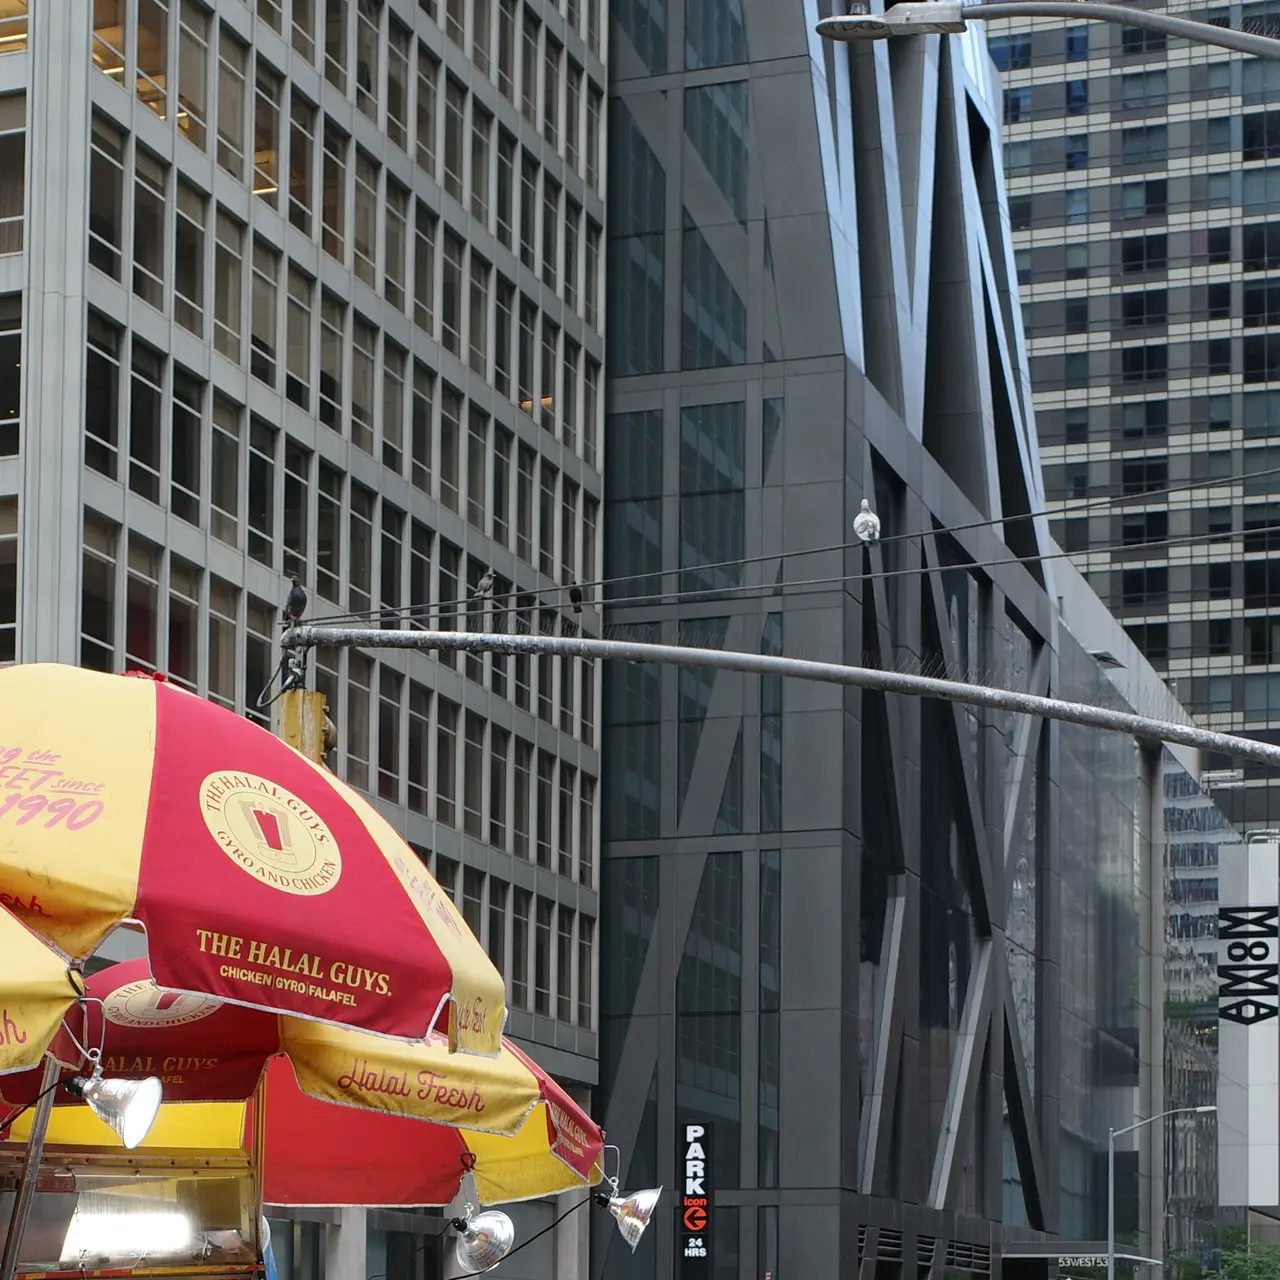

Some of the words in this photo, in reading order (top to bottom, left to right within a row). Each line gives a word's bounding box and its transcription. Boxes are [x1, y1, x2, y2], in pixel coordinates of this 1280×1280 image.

[26, 748, 62, 764] the
[52, 776, 106, 795] since
[206, 780, 226, 812] THE
[220, 775, 282, 800] HALAL
[286, 798, 330, 845] GUYS
[217, 830, 254, 868] GYRO
[256, 866, 291, 888] AND
[292, 858, 337, 890] CHICKEN
[196, 929, 243, 962] THE
[247, 940, 324, 981] HALAL
[114, 982, 146, 1000] THE
[218, 964, 273, 989] CHICKEN
[275, 974, 306, 995] GYRO
[308, 981, 358, 1007] FALAFEL
[154, 1003, 218, 1028] CHICKEN
[336, 1057, 411, 1099] Halal
[685, 1125, 706, 1195] PARK
[683, 1197, 707, 1206] icon
[684, 1248, 707, 1257] HRS
[688, 1238, 703, 1247] 24
